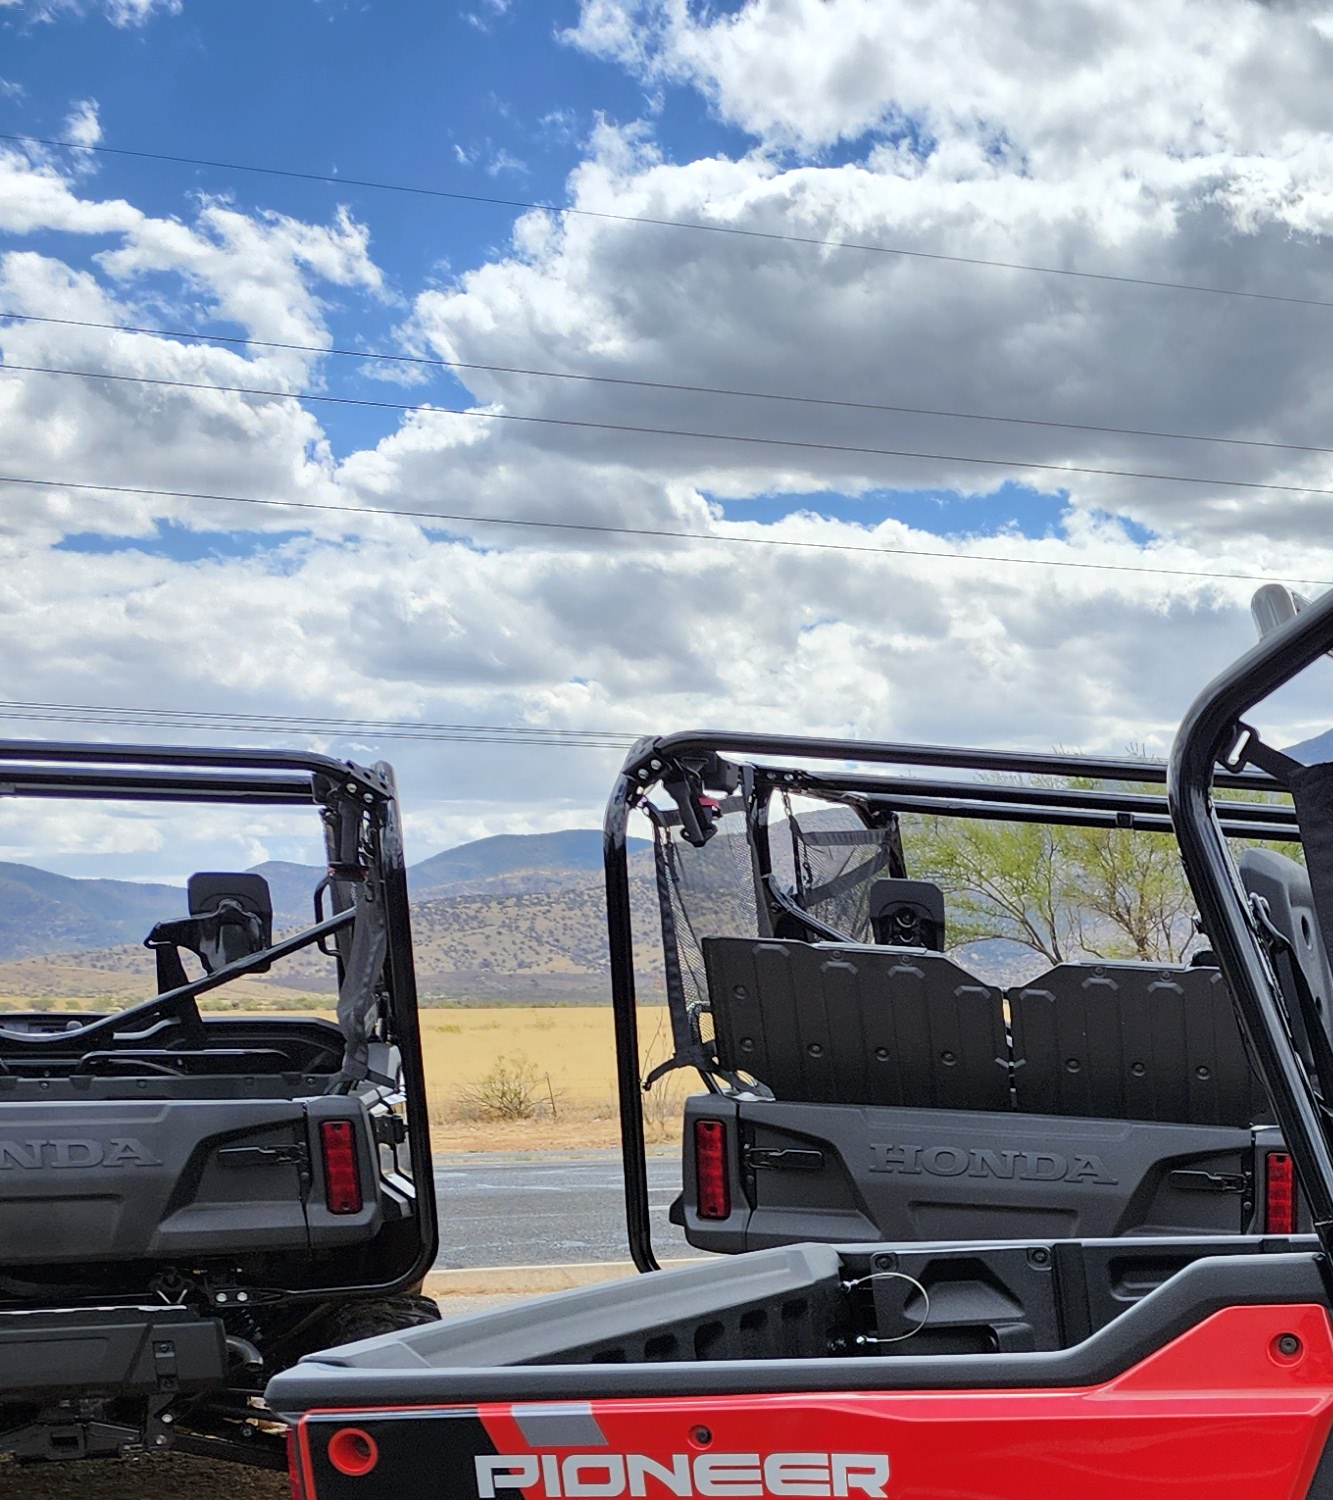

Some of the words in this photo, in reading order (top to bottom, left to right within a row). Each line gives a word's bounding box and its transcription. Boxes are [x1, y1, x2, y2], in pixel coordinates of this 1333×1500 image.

[0, 1138, 164, 1171] NDA
[868, 1143, 1120, 1186] HONDA
[474, 1453, 890, 1499] PIONEER
